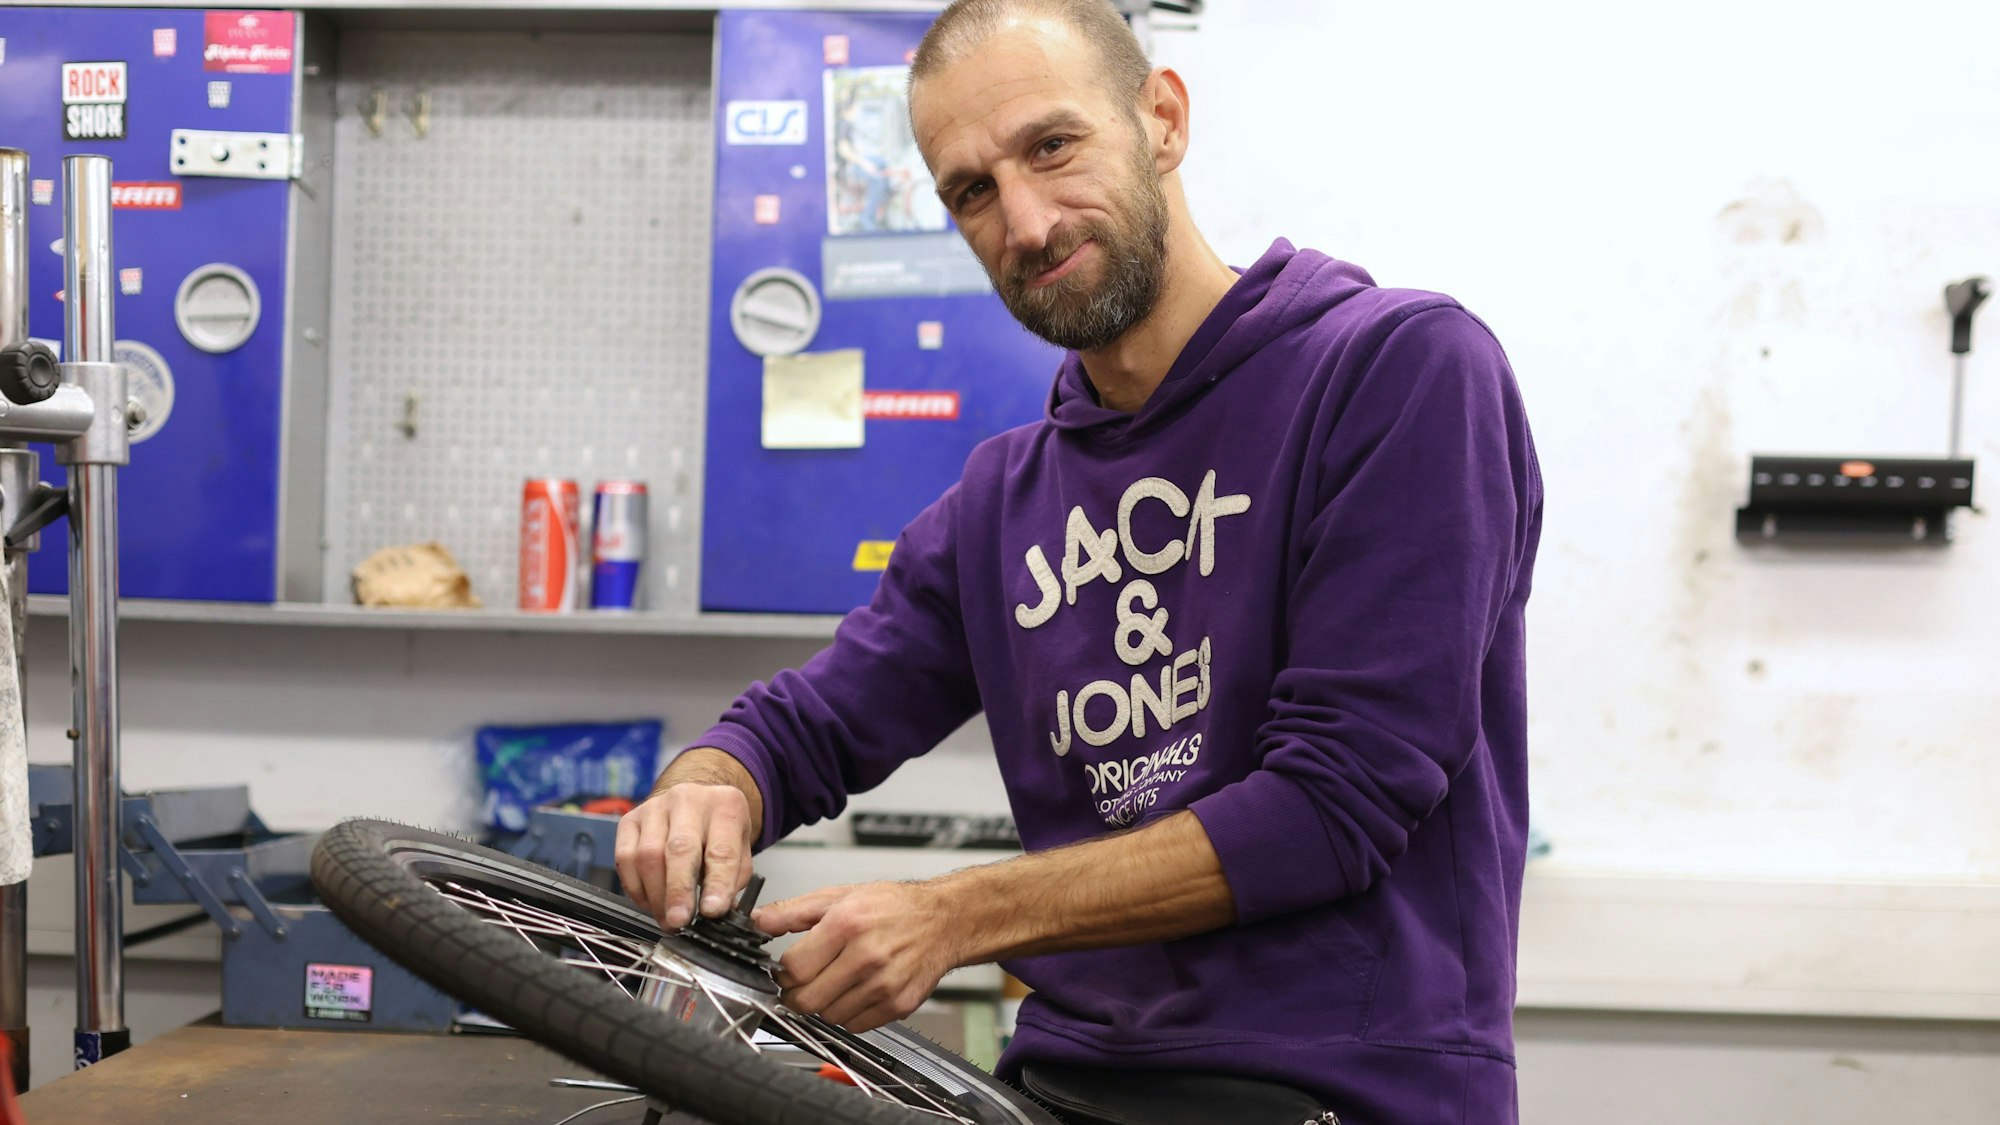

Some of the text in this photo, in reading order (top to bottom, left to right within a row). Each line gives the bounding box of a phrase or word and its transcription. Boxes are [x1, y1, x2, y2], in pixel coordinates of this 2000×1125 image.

[68, 68, 120, 96] ROCK
[66, 104, 123, 138] SHOX
[1015, 469, 1251, 629] JACK
[1114, 579, 1174, 665] &
[1050, 636, 1211, 757] JONES
[1105, 787, 1160, 827] INCE 1975
[312, 970, 360, 982] MADE
